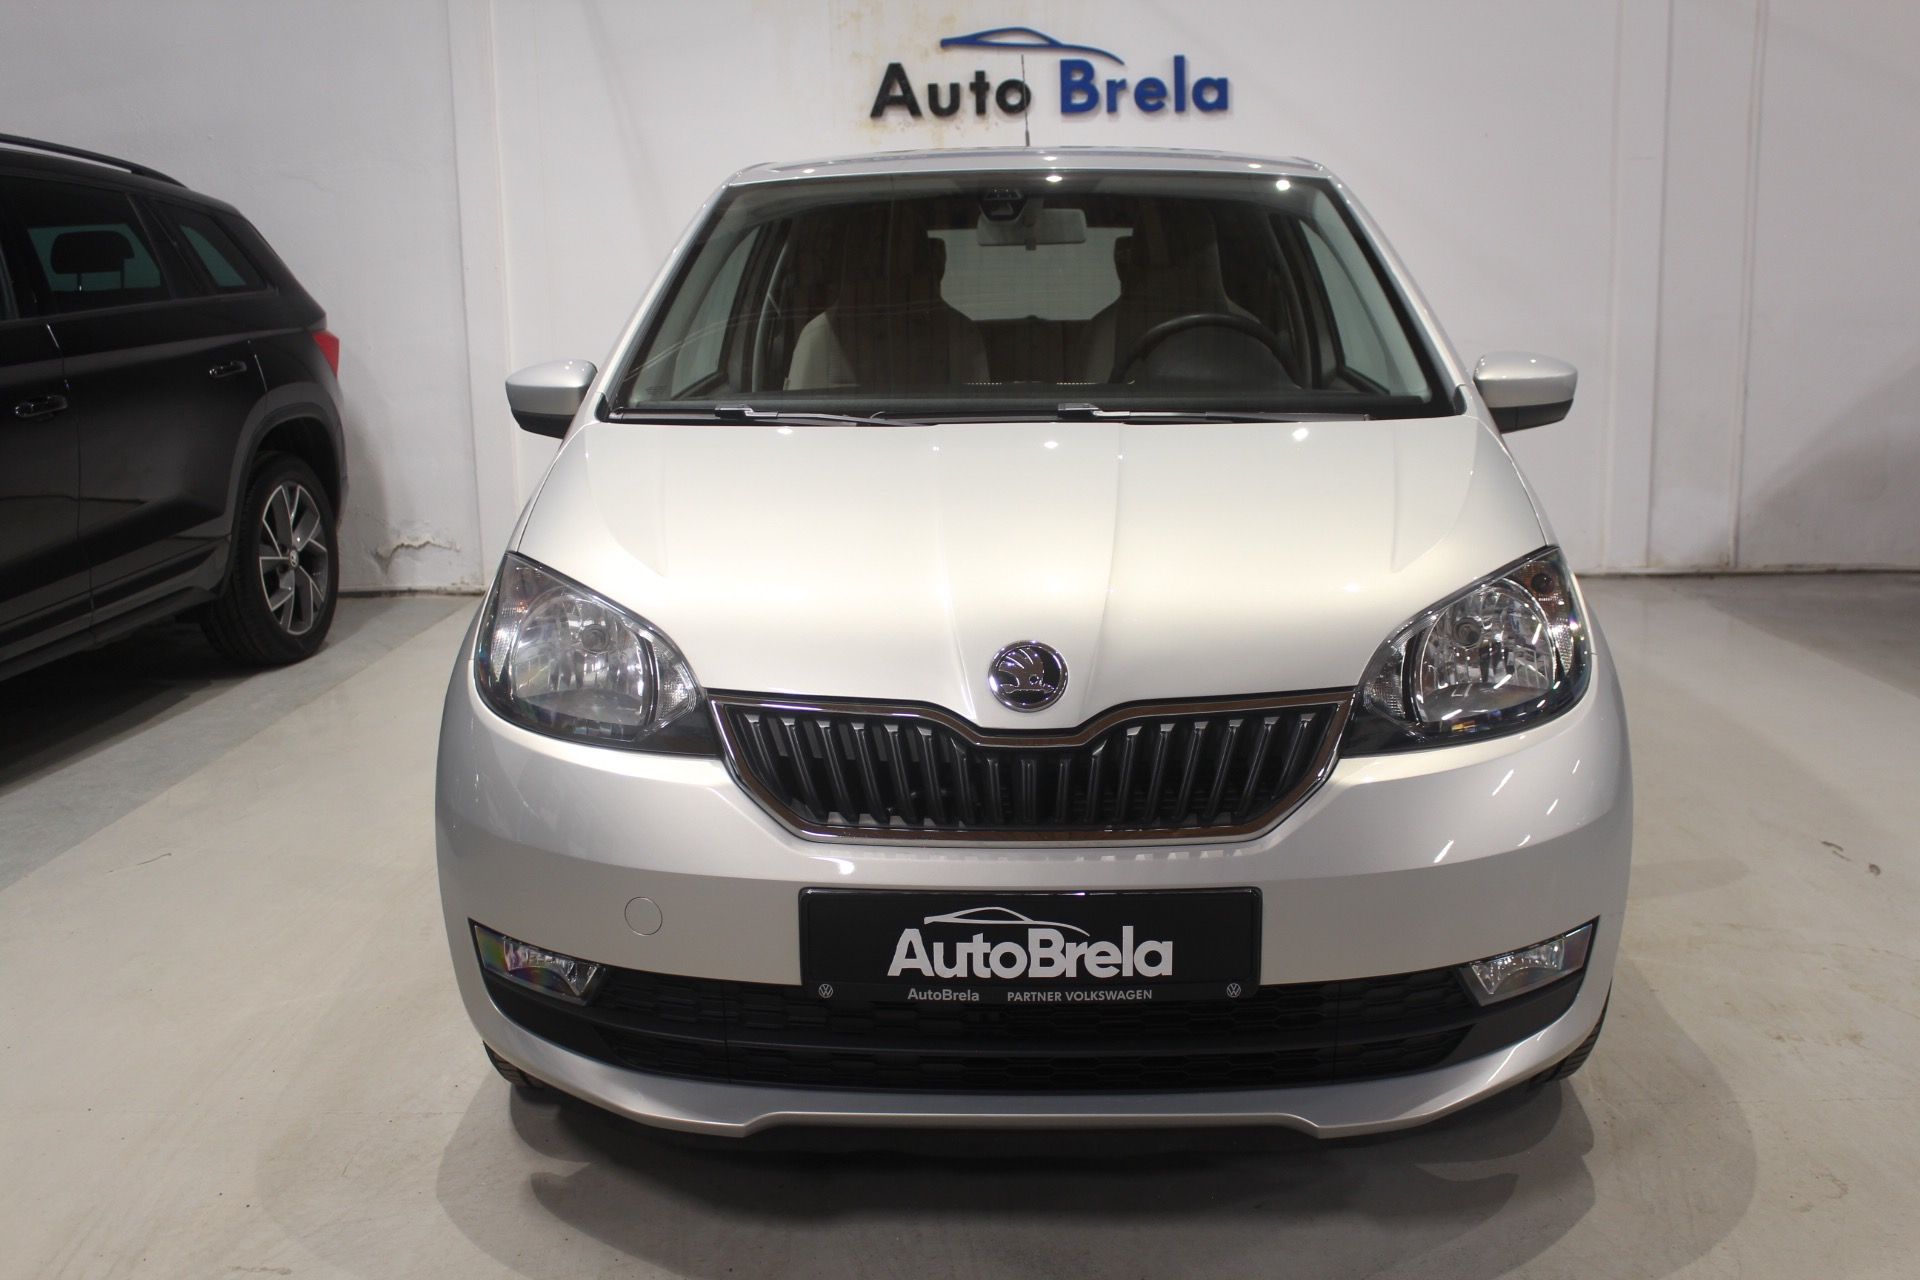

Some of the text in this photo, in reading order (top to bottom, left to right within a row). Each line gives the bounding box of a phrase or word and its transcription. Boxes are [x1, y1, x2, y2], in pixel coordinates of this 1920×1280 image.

[870, 55, 1229, 118] Auto Brela
[887, 925, 1173, 978] AutoBrela
[907, 987, 980, 1002] AutoBrela
[1007, 989, 1153, 1002] PARTNER VOLKSWAGEN
